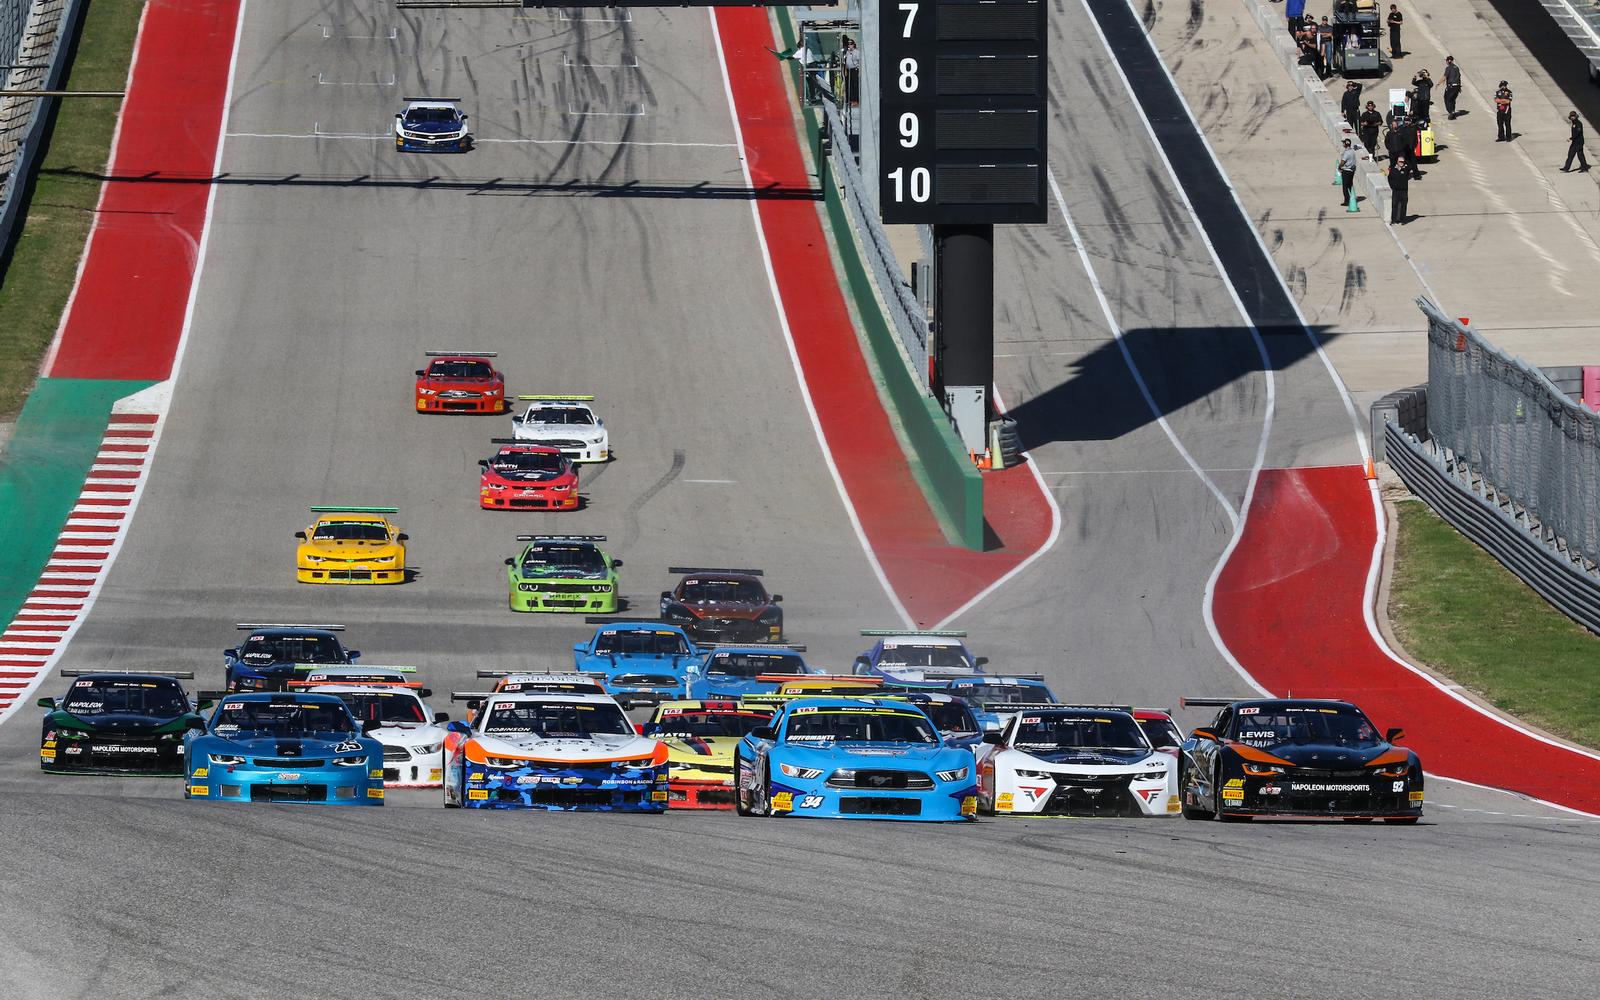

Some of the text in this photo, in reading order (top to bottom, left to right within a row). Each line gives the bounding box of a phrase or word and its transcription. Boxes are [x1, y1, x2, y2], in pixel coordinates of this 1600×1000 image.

[898, 3, 919, 38] 7
[898, 58, 919, 93] 8
[899, 112, 919, 148] 9
[887, 167, 931, 202] 10
[801, 796, 824, 808] 34
[1291, 783, 1325, 791] NAPOLEON
[1392, 781, 1404, 792] 92
